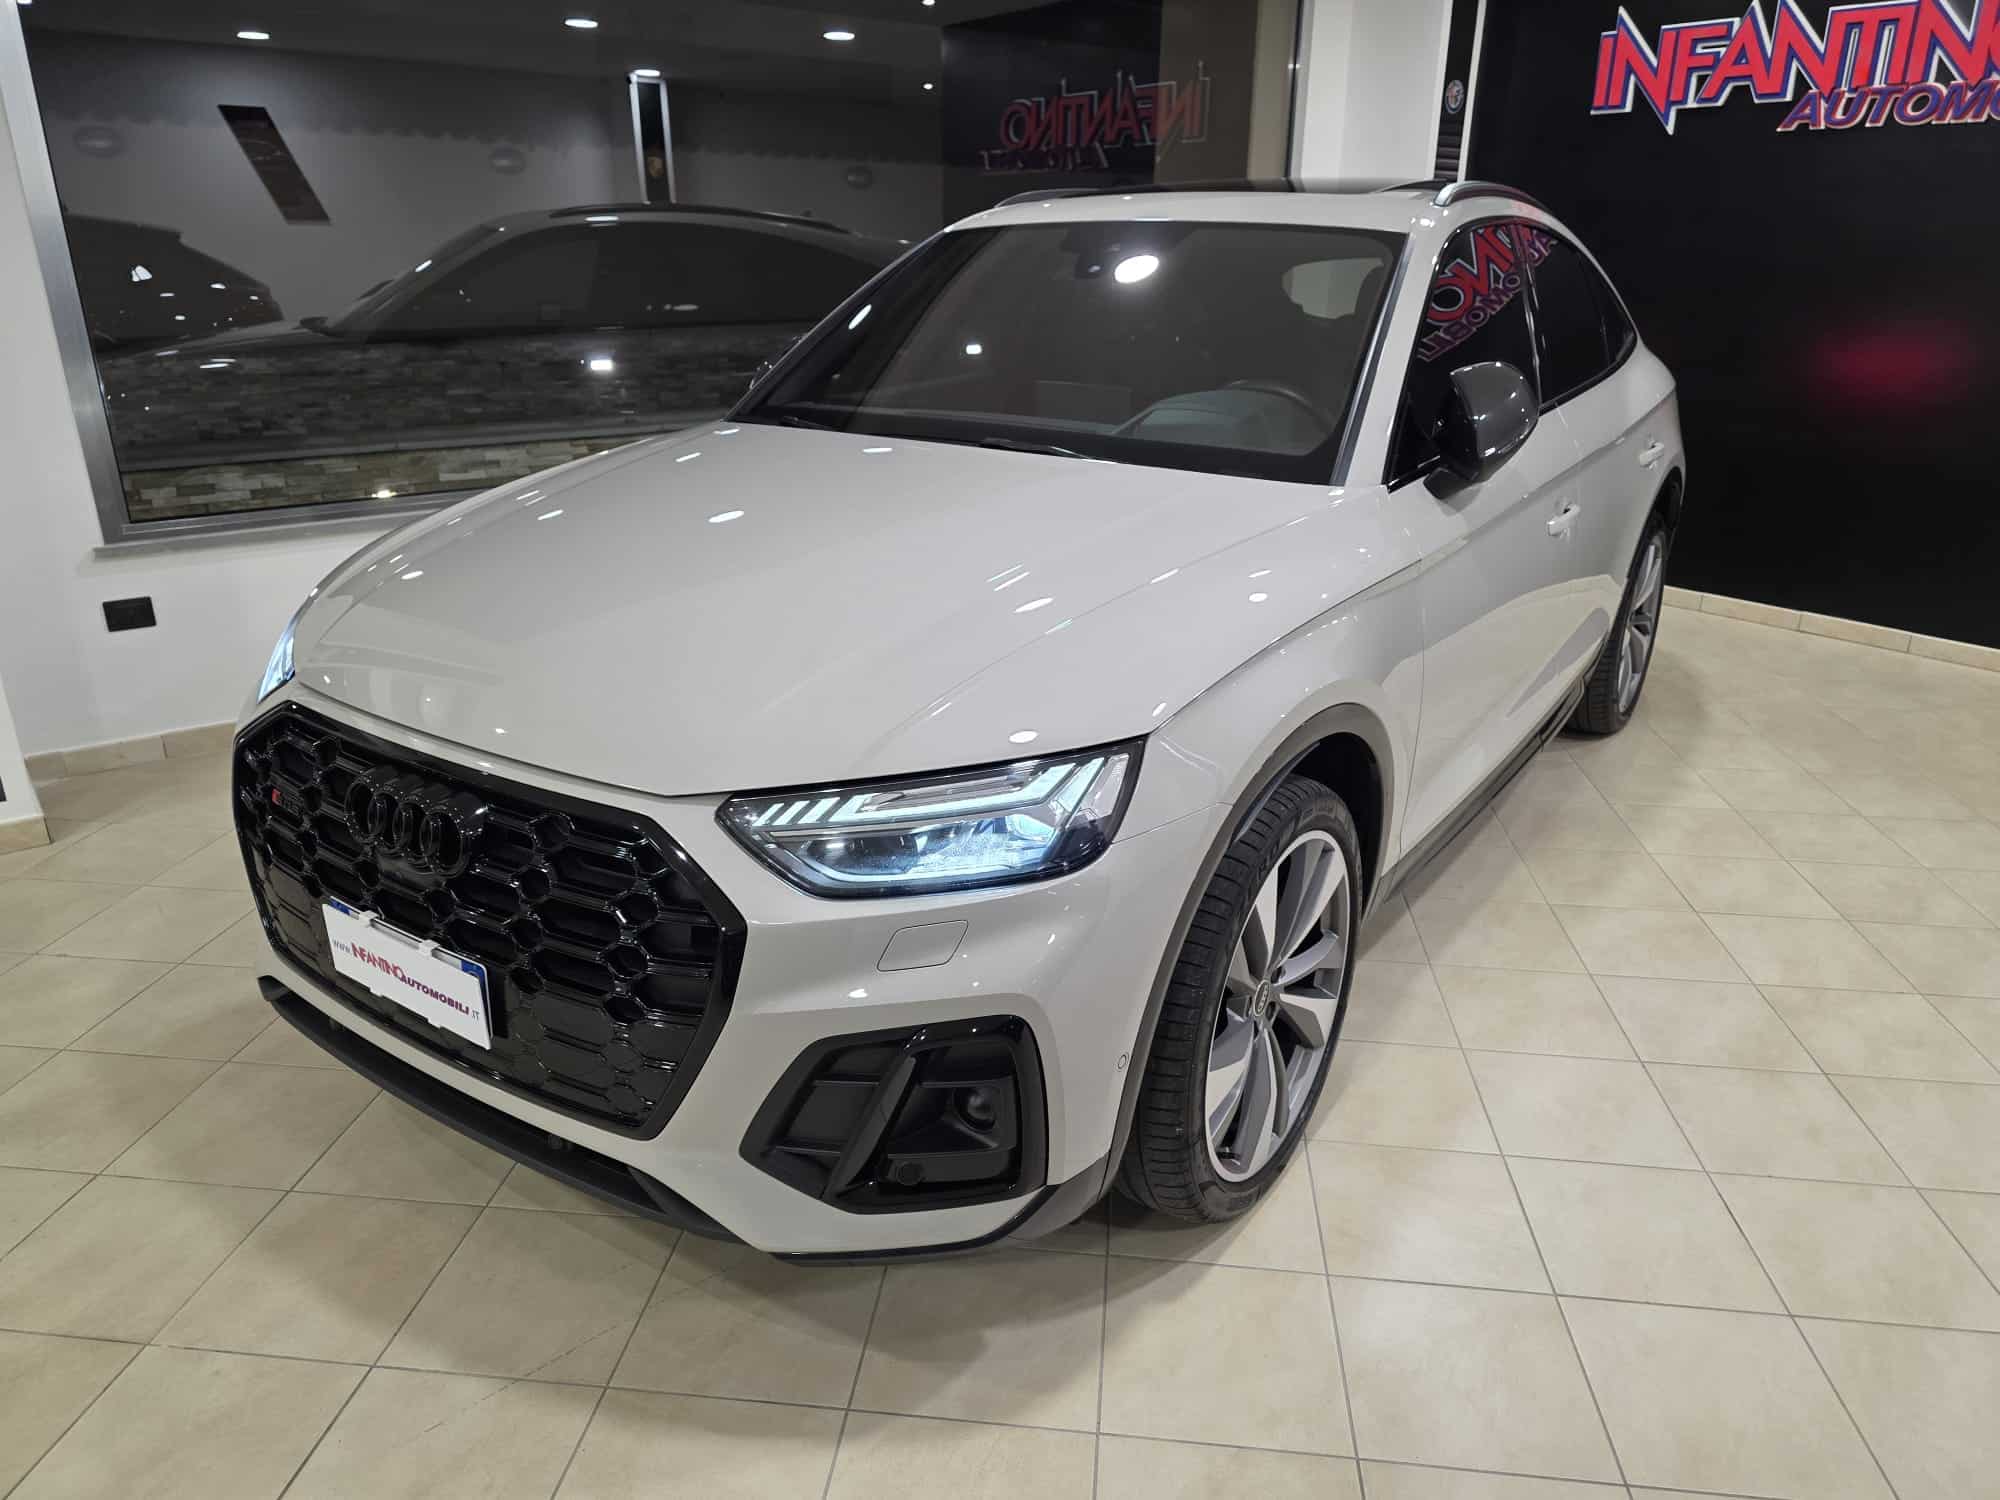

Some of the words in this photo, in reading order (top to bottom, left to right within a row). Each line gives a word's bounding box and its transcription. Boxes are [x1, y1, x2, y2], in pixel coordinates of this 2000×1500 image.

[1591, 0, 2000, 135] INFANTIN
[1776, 79, 2000, 132] AUTOM
[399, 974, 470, 1016] AUTOMOBILI
